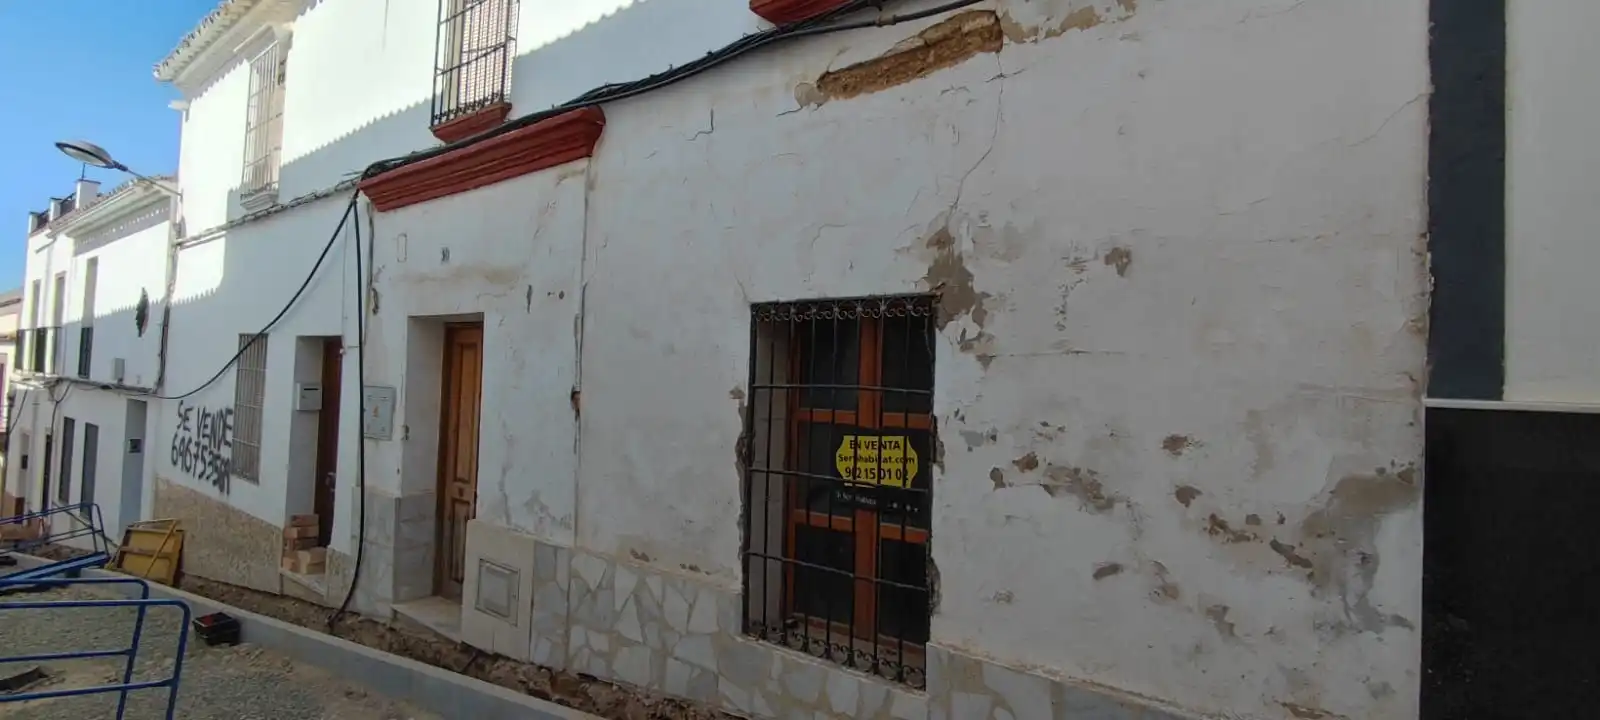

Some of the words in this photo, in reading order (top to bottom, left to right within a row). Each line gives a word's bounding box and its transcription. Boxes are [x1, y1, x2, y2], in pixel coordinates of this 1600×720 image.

[177, 400, 194, 432] SE
[197, 406, 233, 451] VENDE
[849, 440, 861, 450] EN
[864, 440, 900, 451] VENTA
[838, 453, 915, 465] Serhabiat.com
